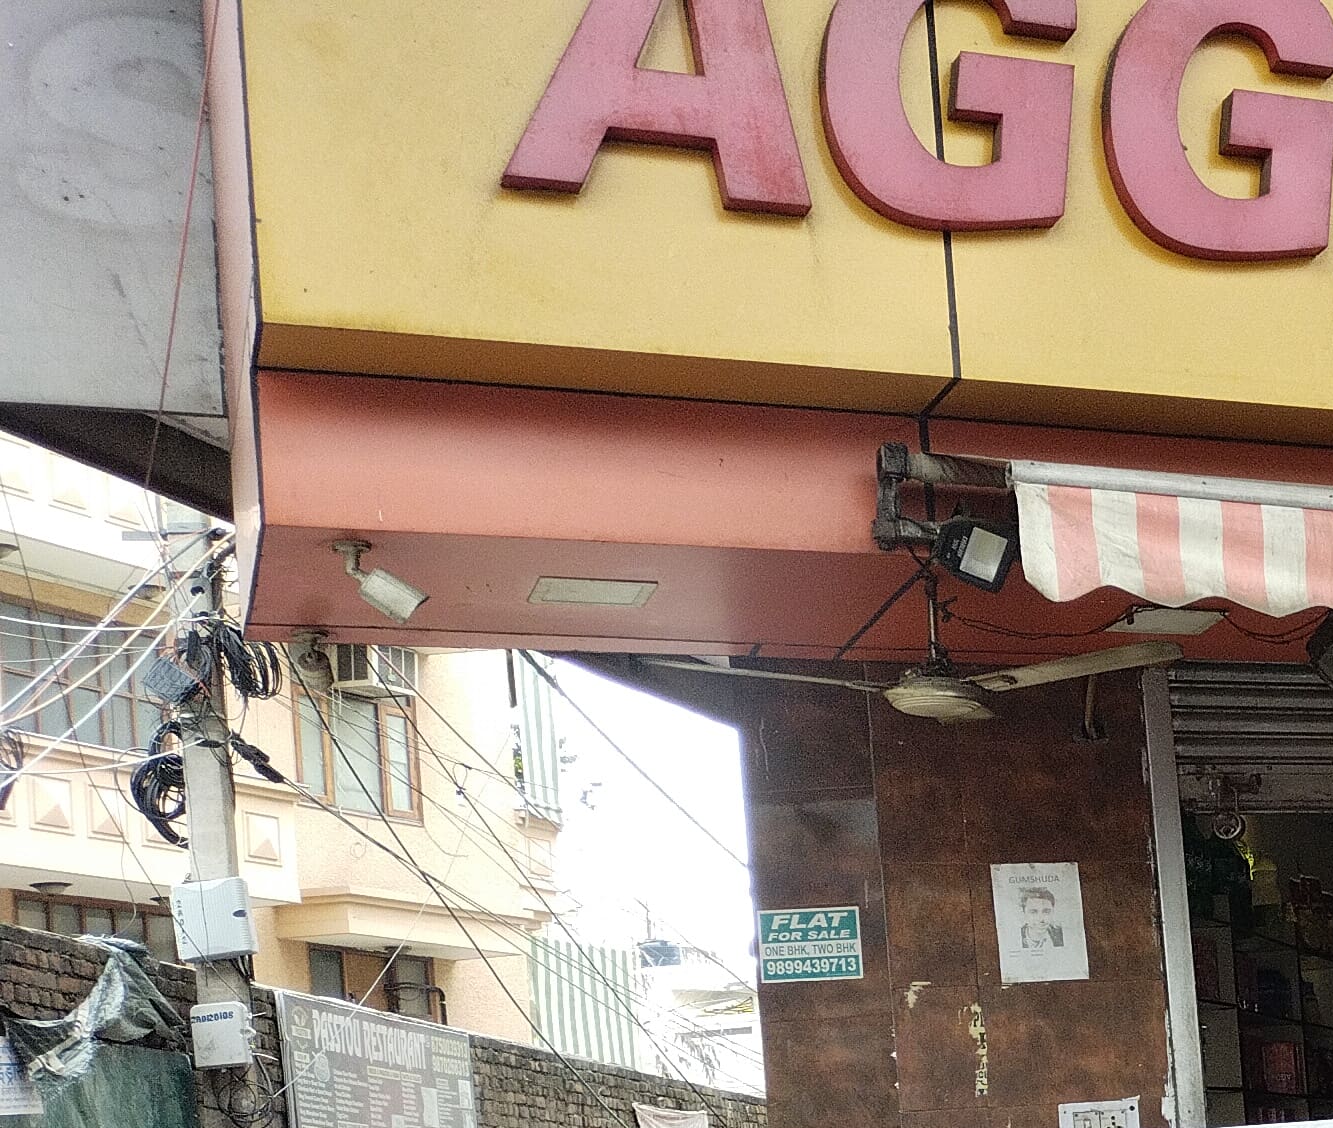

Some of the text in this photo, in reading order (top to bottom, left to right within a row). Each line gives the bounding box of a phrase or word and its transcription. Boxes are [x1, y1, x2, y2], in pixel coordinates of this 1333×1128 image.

[1008, 875, 1060, 884] GUMSHUDA
[771, 911, 848, 930] FLAT
[767, 929, 851, 942] FOR SALE
[764, 942, 857, 957] ONE BHK, TWO BHK
[766, 957, 857, 976] 9899439713
[362, 1020, 427, 1072] RESTAURANT
